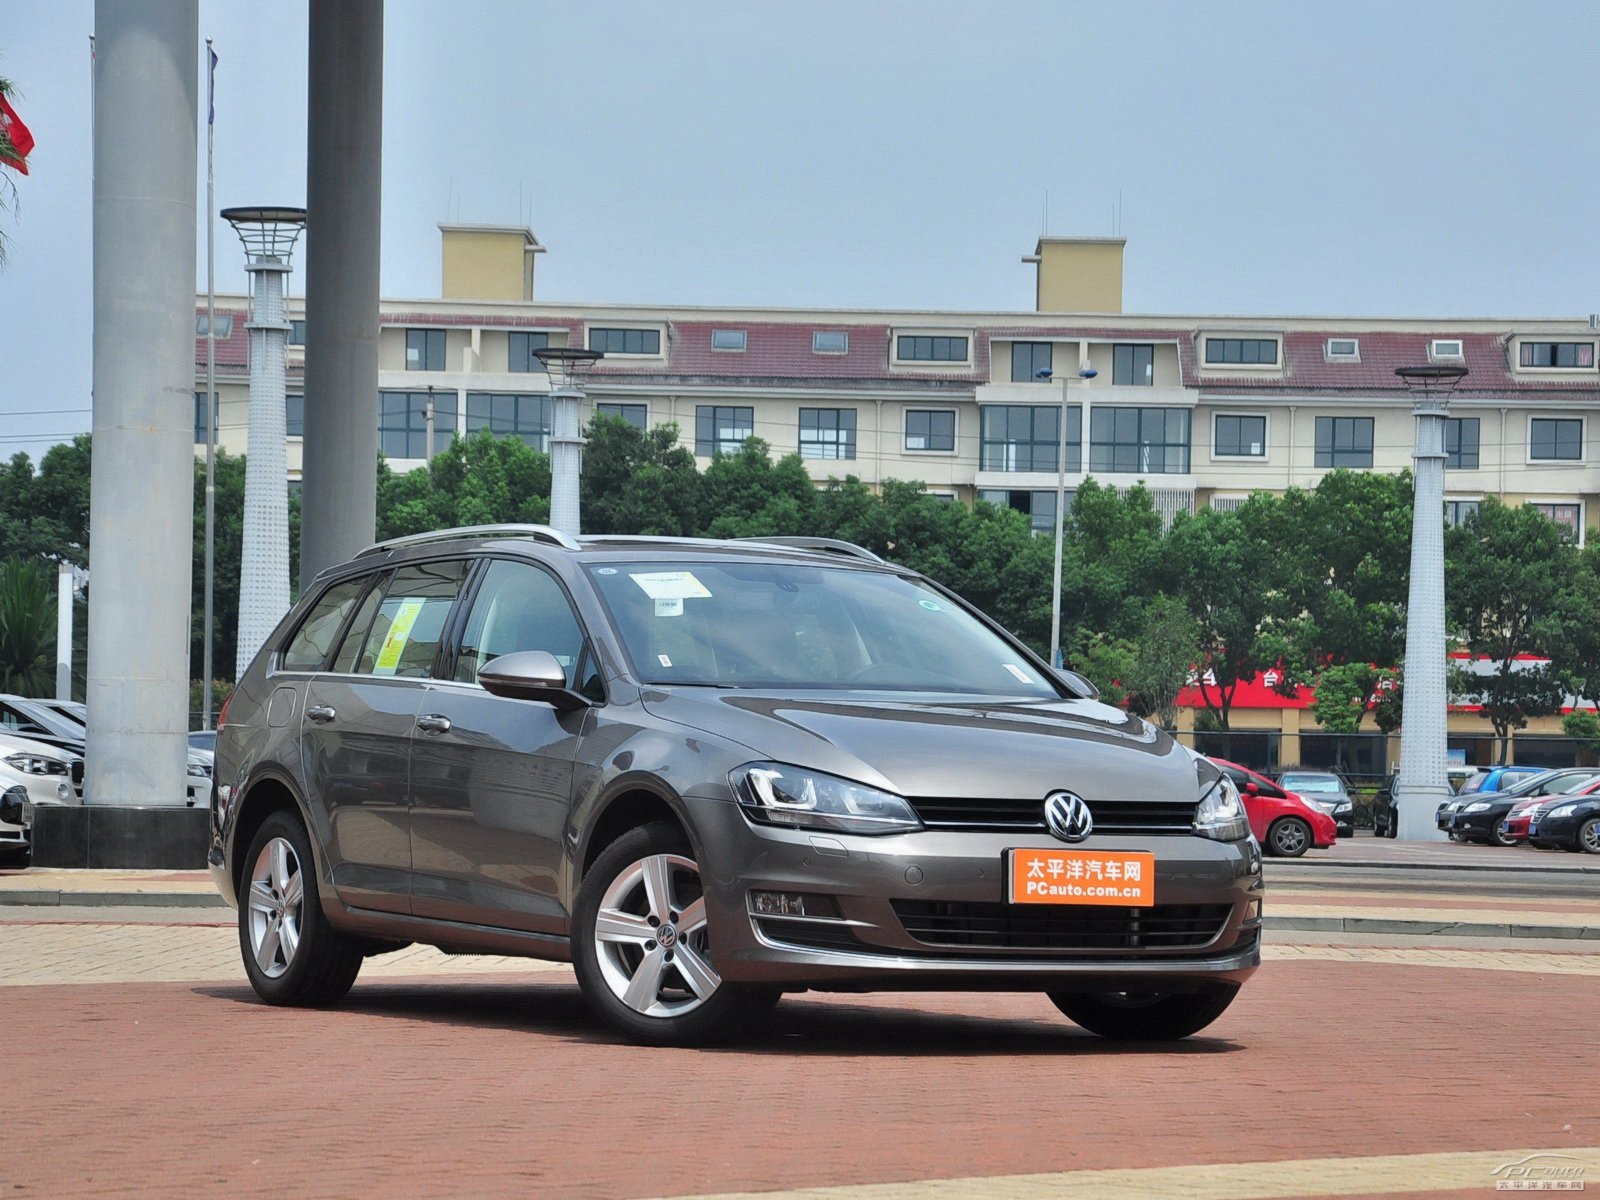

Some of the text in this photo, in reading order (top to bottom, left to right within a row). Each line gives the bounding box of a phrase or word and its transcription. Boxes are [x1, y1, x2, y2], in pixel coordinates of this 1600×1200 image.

[1027, 858, 1141, 881] 太平洋汽车网
[1027, 882, 1141, 897] PCauto.com.cn
